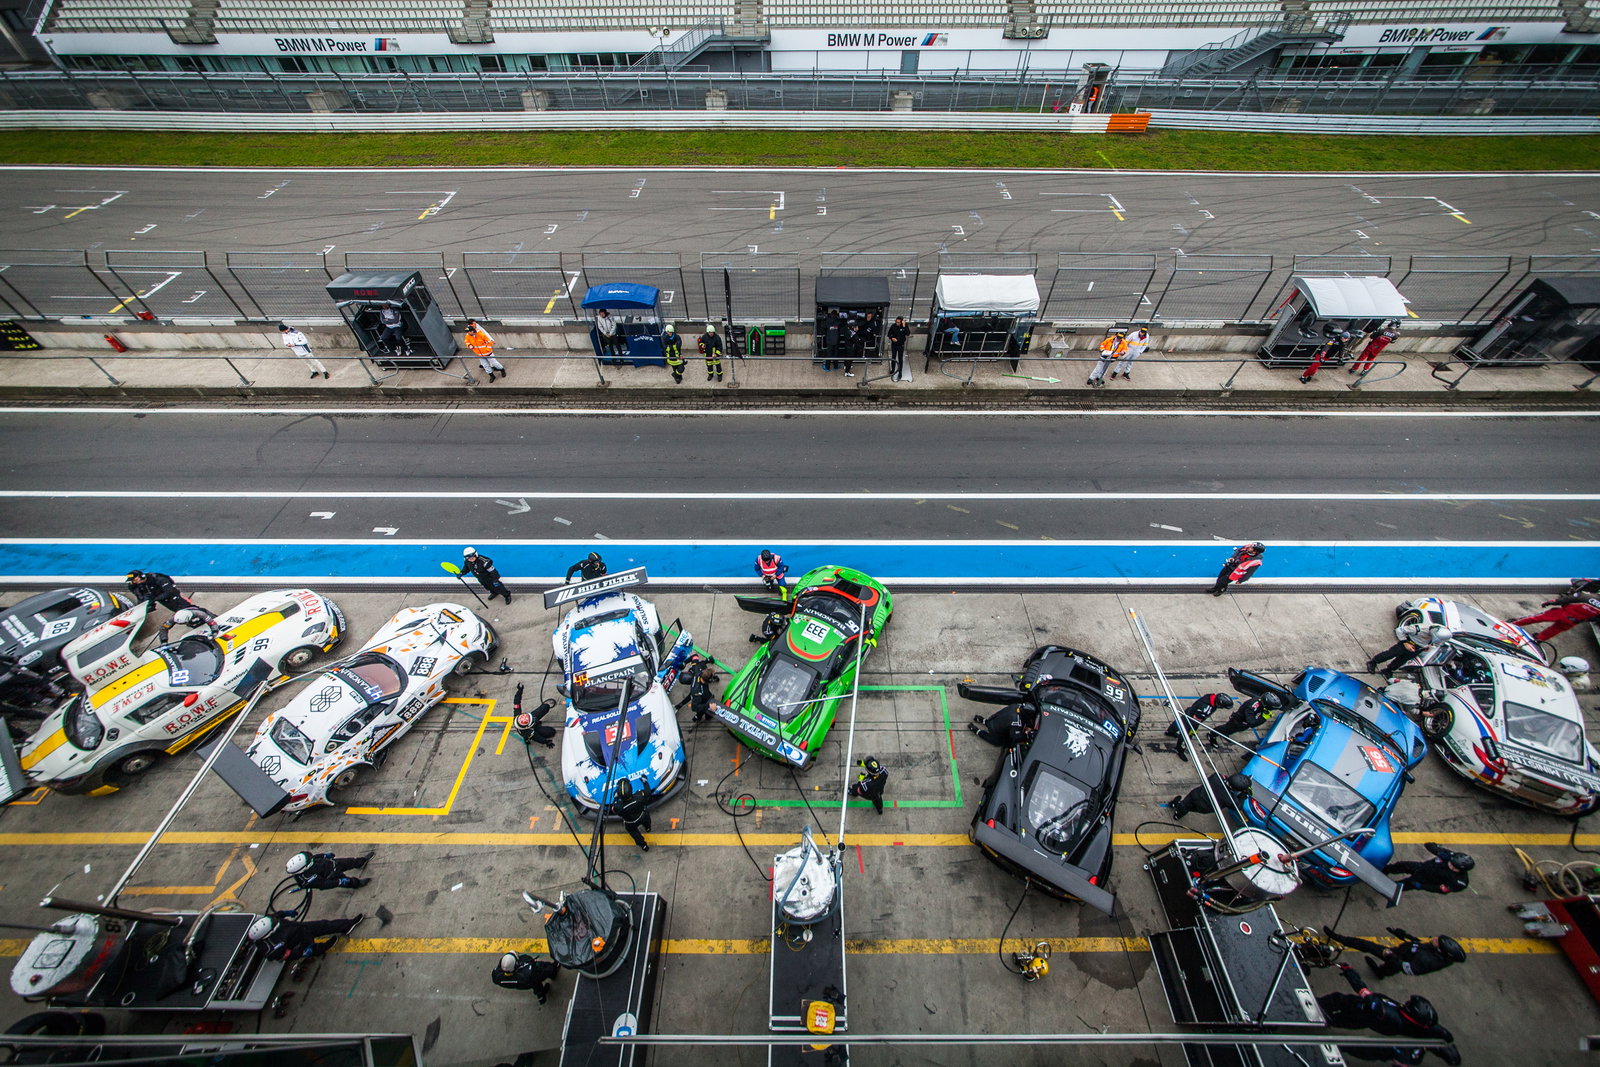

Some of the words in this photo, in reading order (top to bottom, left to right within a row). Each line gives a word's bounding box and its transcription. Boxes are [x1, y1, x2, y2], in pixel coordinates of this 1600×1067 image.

[274, 38, 312, 52] BMW
[311, 39, 327, 52] M
[325, 39, 367, 53] Power
[828, 33, 861, 47] BMW
[864, 34, 875, 47] M
[878, 34, 917, 47] Power
[1379, 28, 1418, 43] BMW
[1431, 28, 1475, 43] Power
[577, 581, 602, 597] HIFI
[602, 571, 638, 591] FILTER
[294, 589, 322, 617] ROWE
[804, 607, 847, 631] BLANCPAIN
[807, 622, 827, 640] 333
[252, 637, 270, 652] 99
[84, 655, 130, 685] ROWE
[89, 669, 119, 686] MOTOR
[118, 661, 132, 673] OIL
[417, 657, 436, 676] 888
[573, 672, 590, 686] 44
[584, 666, 636, 688] BLANCPAIN
[162, 697, 218, 735] ROWE
[170, 714, 203, 736] MOTOR
[202, 703, 219, 717] OIL
[404, 701, 423, 719] 888
[591, 704, 638, 724] REALSOLUONS
[714, 708, 740, 726] GROU
[1050, 705, 1094, 727] BLANCPAIN
[739, 720, 777, 747] CAPITAL
[1369, 750, 1387, 770] 56
[1562, 770, 1578, 784] DU
